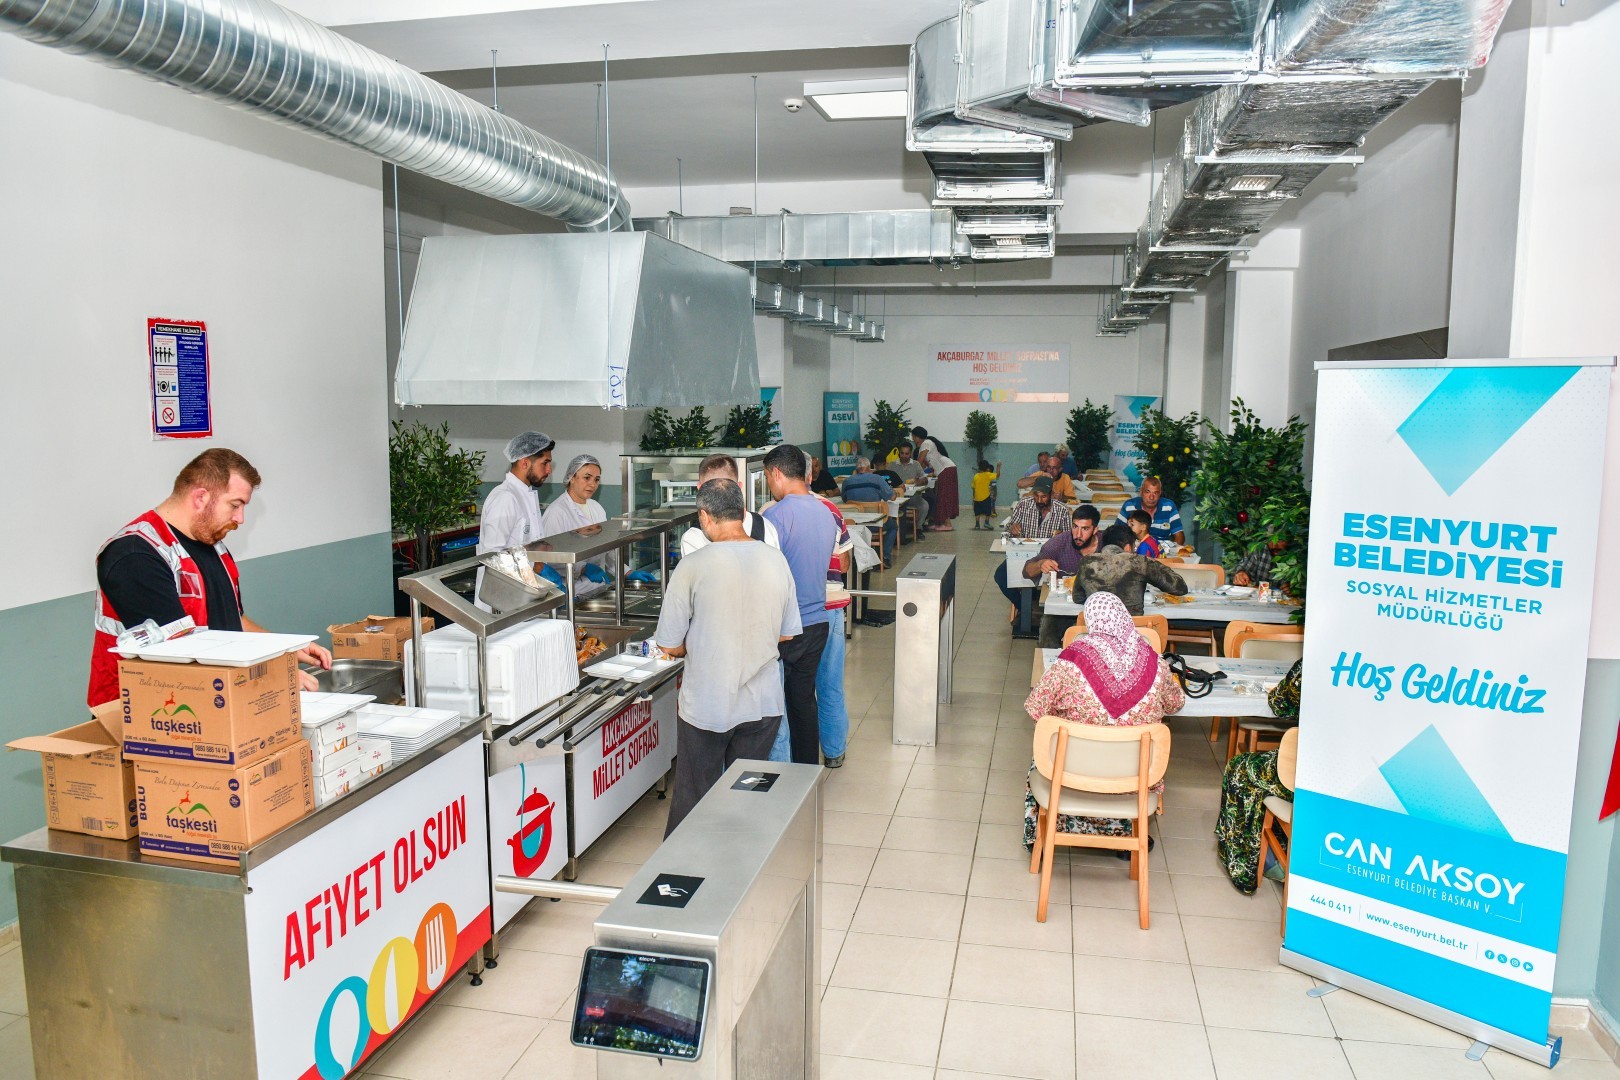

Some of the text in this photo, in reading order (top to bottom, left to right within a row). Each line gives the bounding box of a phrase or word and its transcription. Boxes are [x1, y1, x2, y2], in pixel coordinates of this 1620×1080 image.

[937, 352, 984, 362] AKÇABURGAZ
[973, 363, 987, 374] HOŞ
[832, 412, 854, 422] AŞEVİ
[1342, 512, 1558, 554] ESENYURT
[1334, 542, 1564, 588] BELEDİYESİ
[1346, 580, 1543, 615] SOSYAL HİZMETLER
[1377, 603, 1503, 631] MÜDÜRLÜĞÜ
[1330, 651, 1547, 714] Hoş Geldiniz
[122, 688, 132, 724] BOLU
[151, 718, 201, 735] taşkesti
[593, 720, 659, 800] MİLLET SOFRASI
[138, 786, 147, 821] BOLU
[166, 815, 217, 833] taşkesti
[1324, 832, 1525, 904] CAN AKSOY
[283, 794, 466, 981] AFİYET OLSUN
[1310, 894, 1326, 906] 444
[1336, 902, 1352, 914] 411
[1347, 864, 1493, 915] ESENYURT BELEDİYE BAŞKAN V.
[1366, 912, 1468, 951] www.esenyurt.bel.tr
